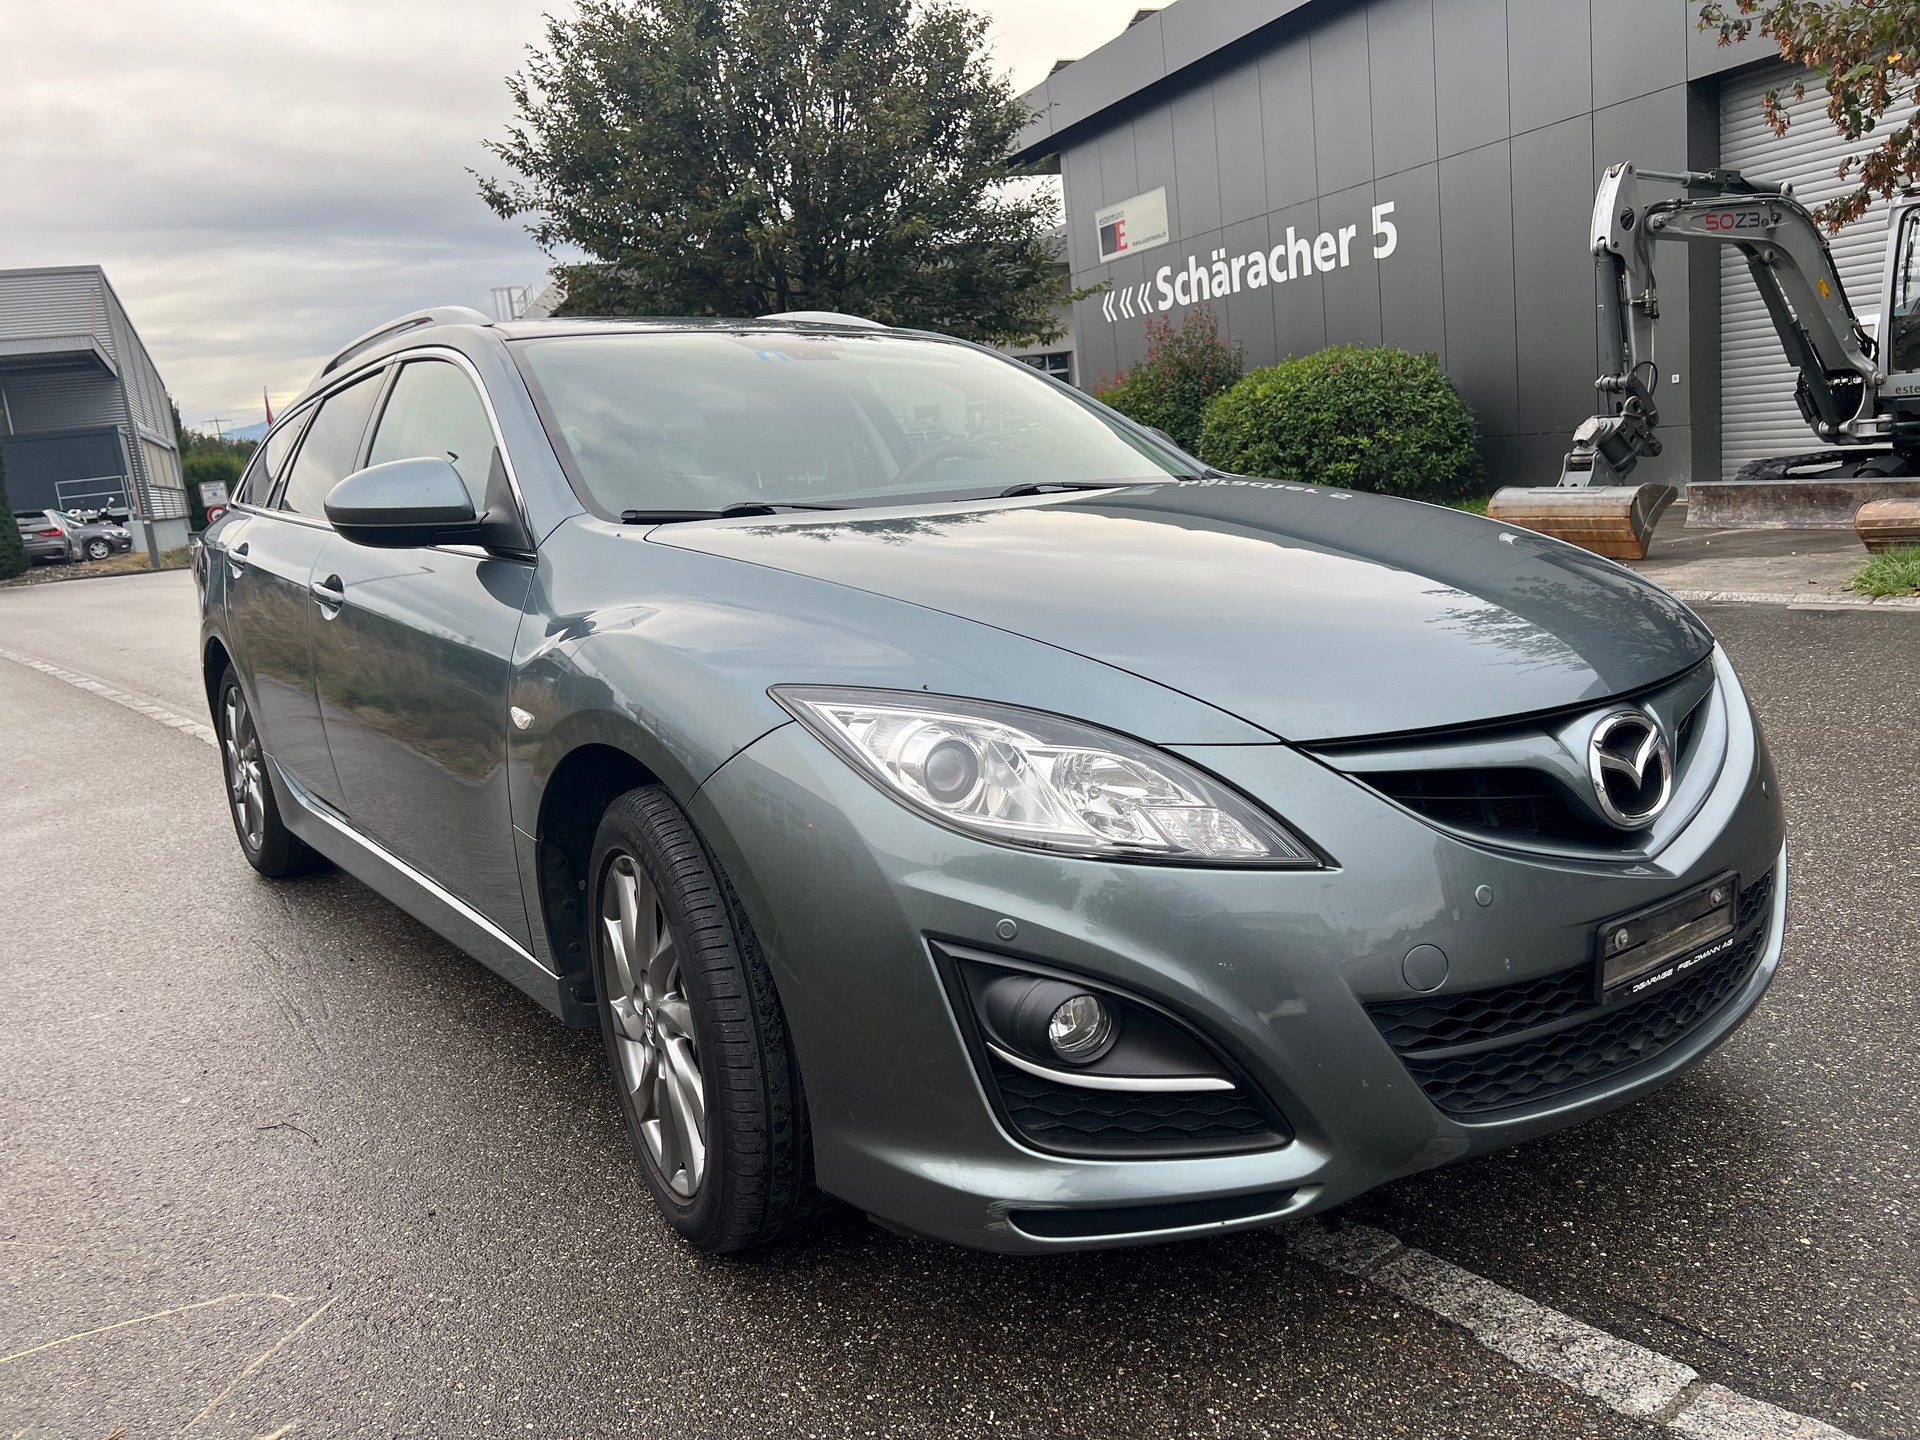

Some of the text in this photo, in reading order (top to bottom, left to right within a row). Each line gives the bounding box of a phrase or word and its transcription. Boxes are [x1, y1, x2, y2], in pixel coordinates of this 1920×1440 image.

[1156, 201, 1398, 311] Schäracher 5
[1677, 945, 1721, 971] FELDMANN
[1722, 938, 1734, 949] AG
